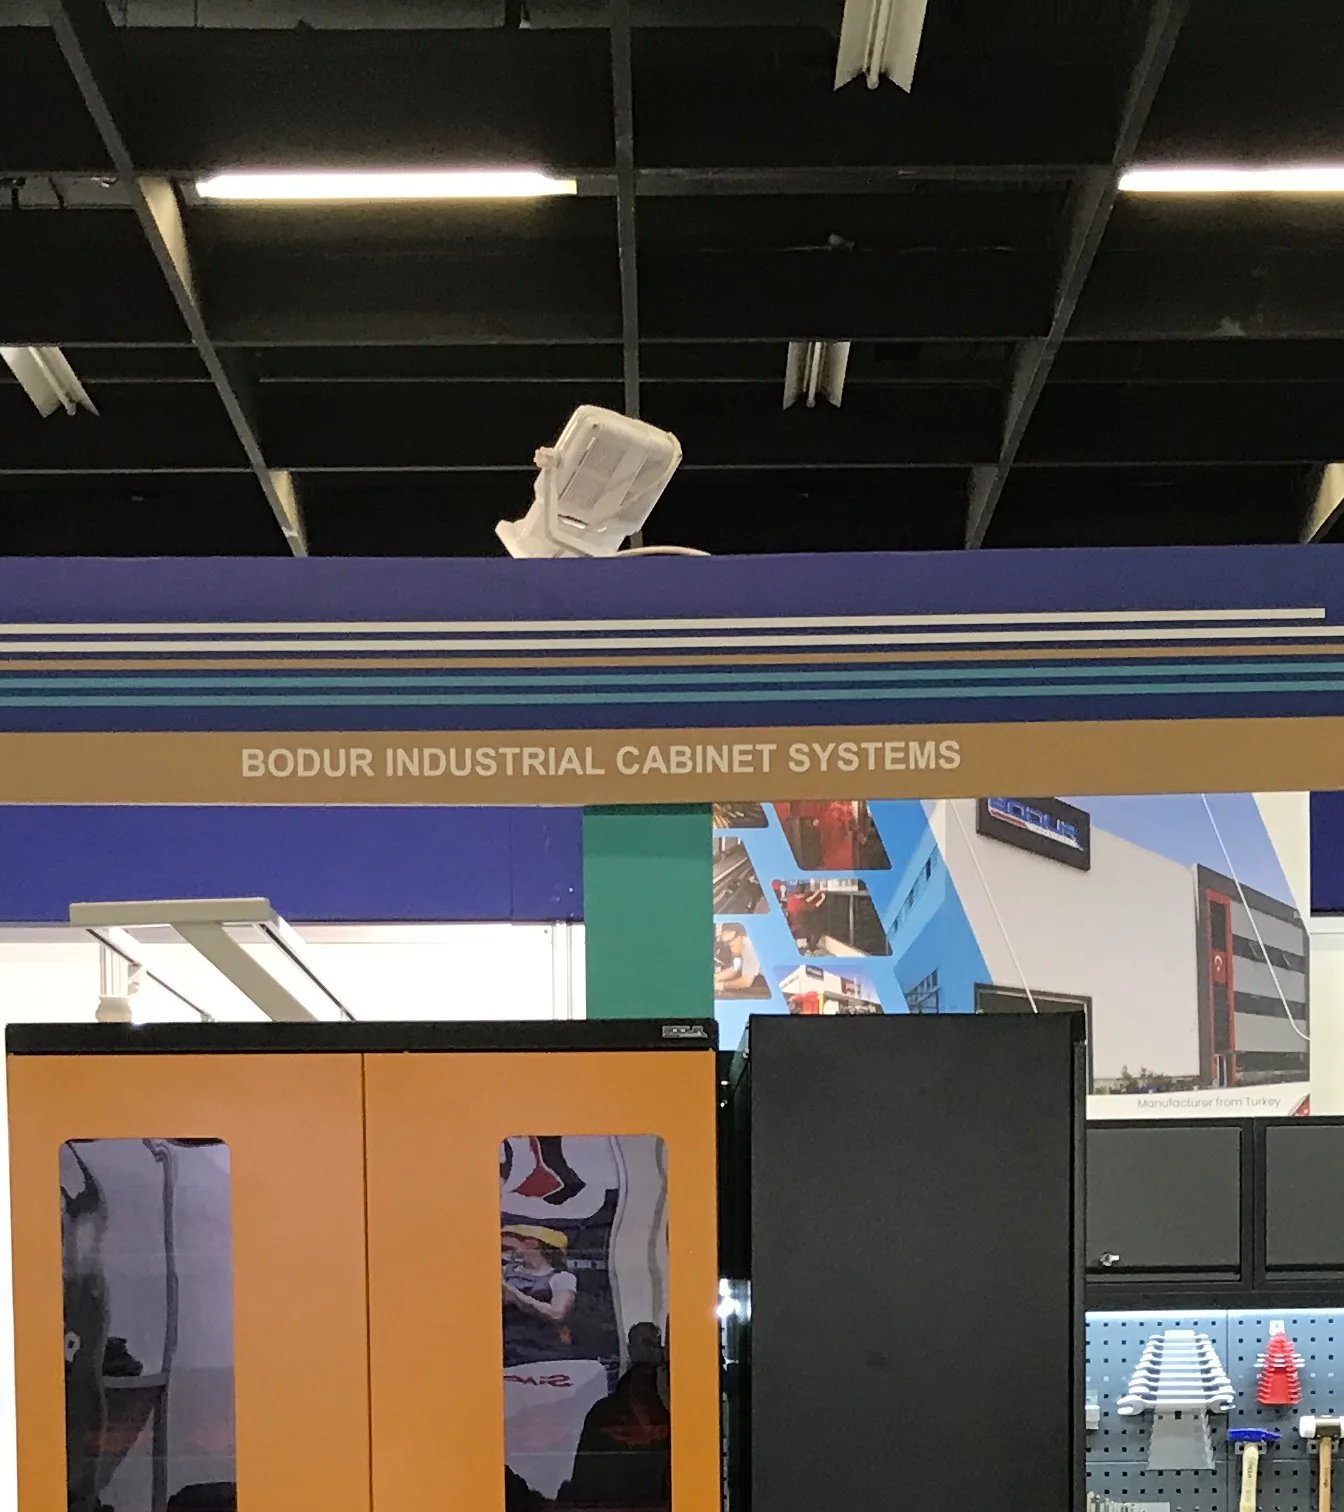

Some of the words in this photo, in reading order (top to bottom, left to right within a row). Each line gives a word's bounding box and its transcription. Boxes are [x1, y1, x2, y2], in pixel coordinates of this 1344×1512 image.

[241, 748, 375, 779] BODUR
[385, 745, 605, 778] INDUSTRIAL
[616, 743, 777, 775] CABINET
[788, 740, 962, 771] SYSTEMS
[1137, 1097, 1213, 1110] Manufacturer
[1216, 1095, 1242, 1108] from
[1246, 1095, 1282, 1109] Turkey
